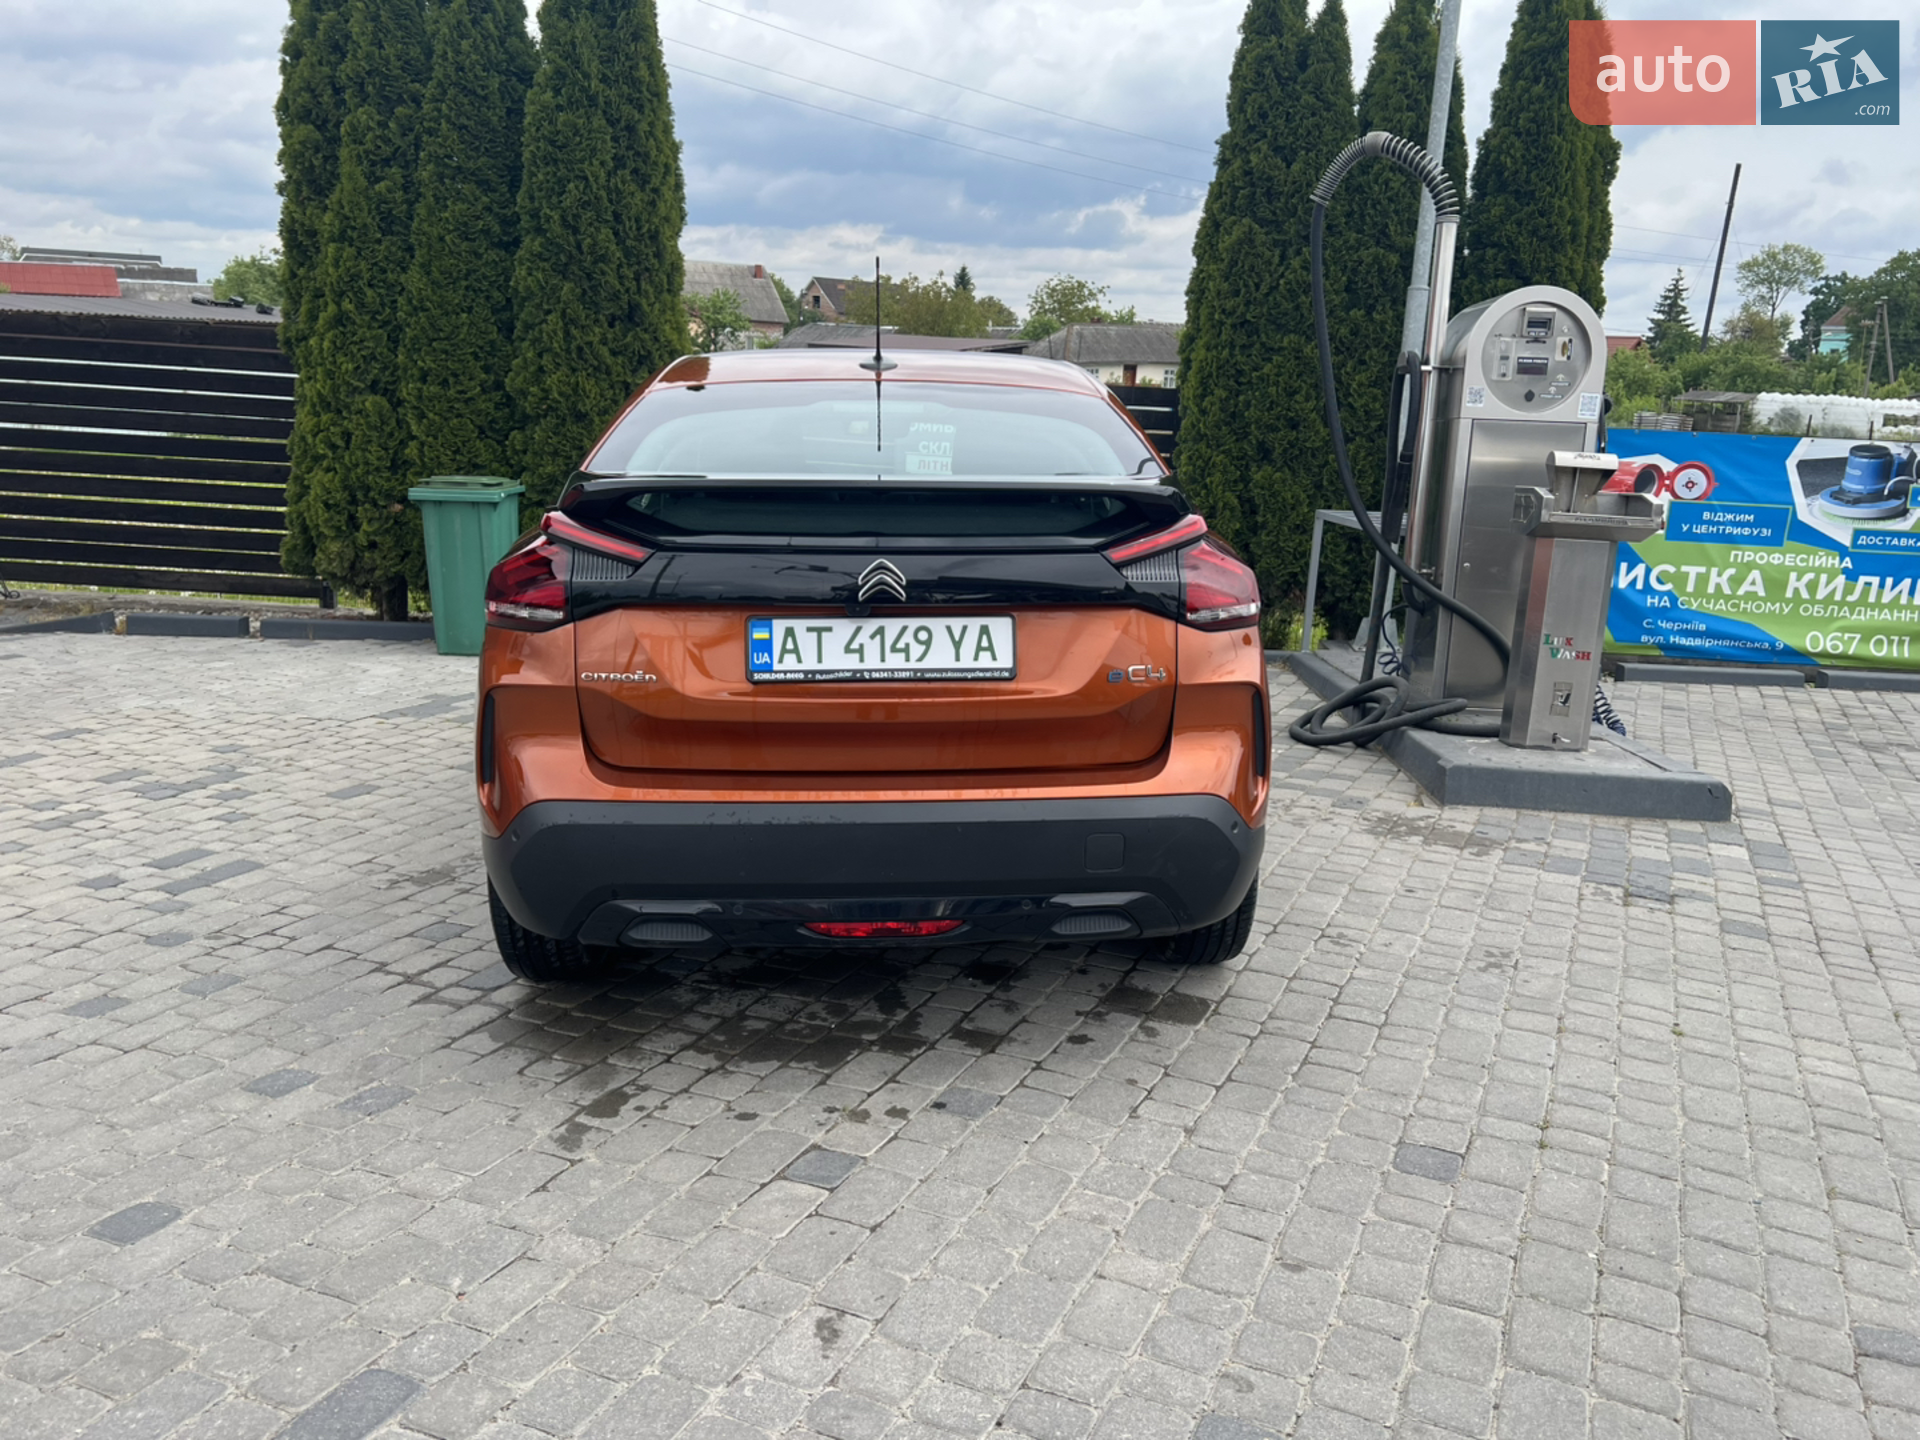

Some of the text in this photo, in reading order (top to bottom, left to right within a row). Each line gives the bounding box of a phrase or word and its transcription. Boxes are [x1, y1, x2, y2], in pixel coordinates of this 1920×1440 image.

[919, 441, 953, 456] СКЛ
[1702, 511, 1754, 523] ВІДЖИМ
[1681, 523, 1772, 537] У ЦЕНТРИФУЗІ
[1729, 550, 1853, 570] ПРОФЕСІЙНА
[1610, 562, 1920, 606] ИСТКА КИЛИ
[1646, 595, 1671, 608] НА
[1677, 596, 1794, 615] СУЧАСНОМУ
[1658, 619, 1707, 632] Черніїв
[777, 624, 998, 664] AT 4149 YA
[1640, 634, 1667, 645] вул.
[1775, 640, 1784, 650] 9
[1805, 631, 1911, 658] 067 011
[753, 653, 771, 665] UA
[1127, 664, 1166, 683] C4
